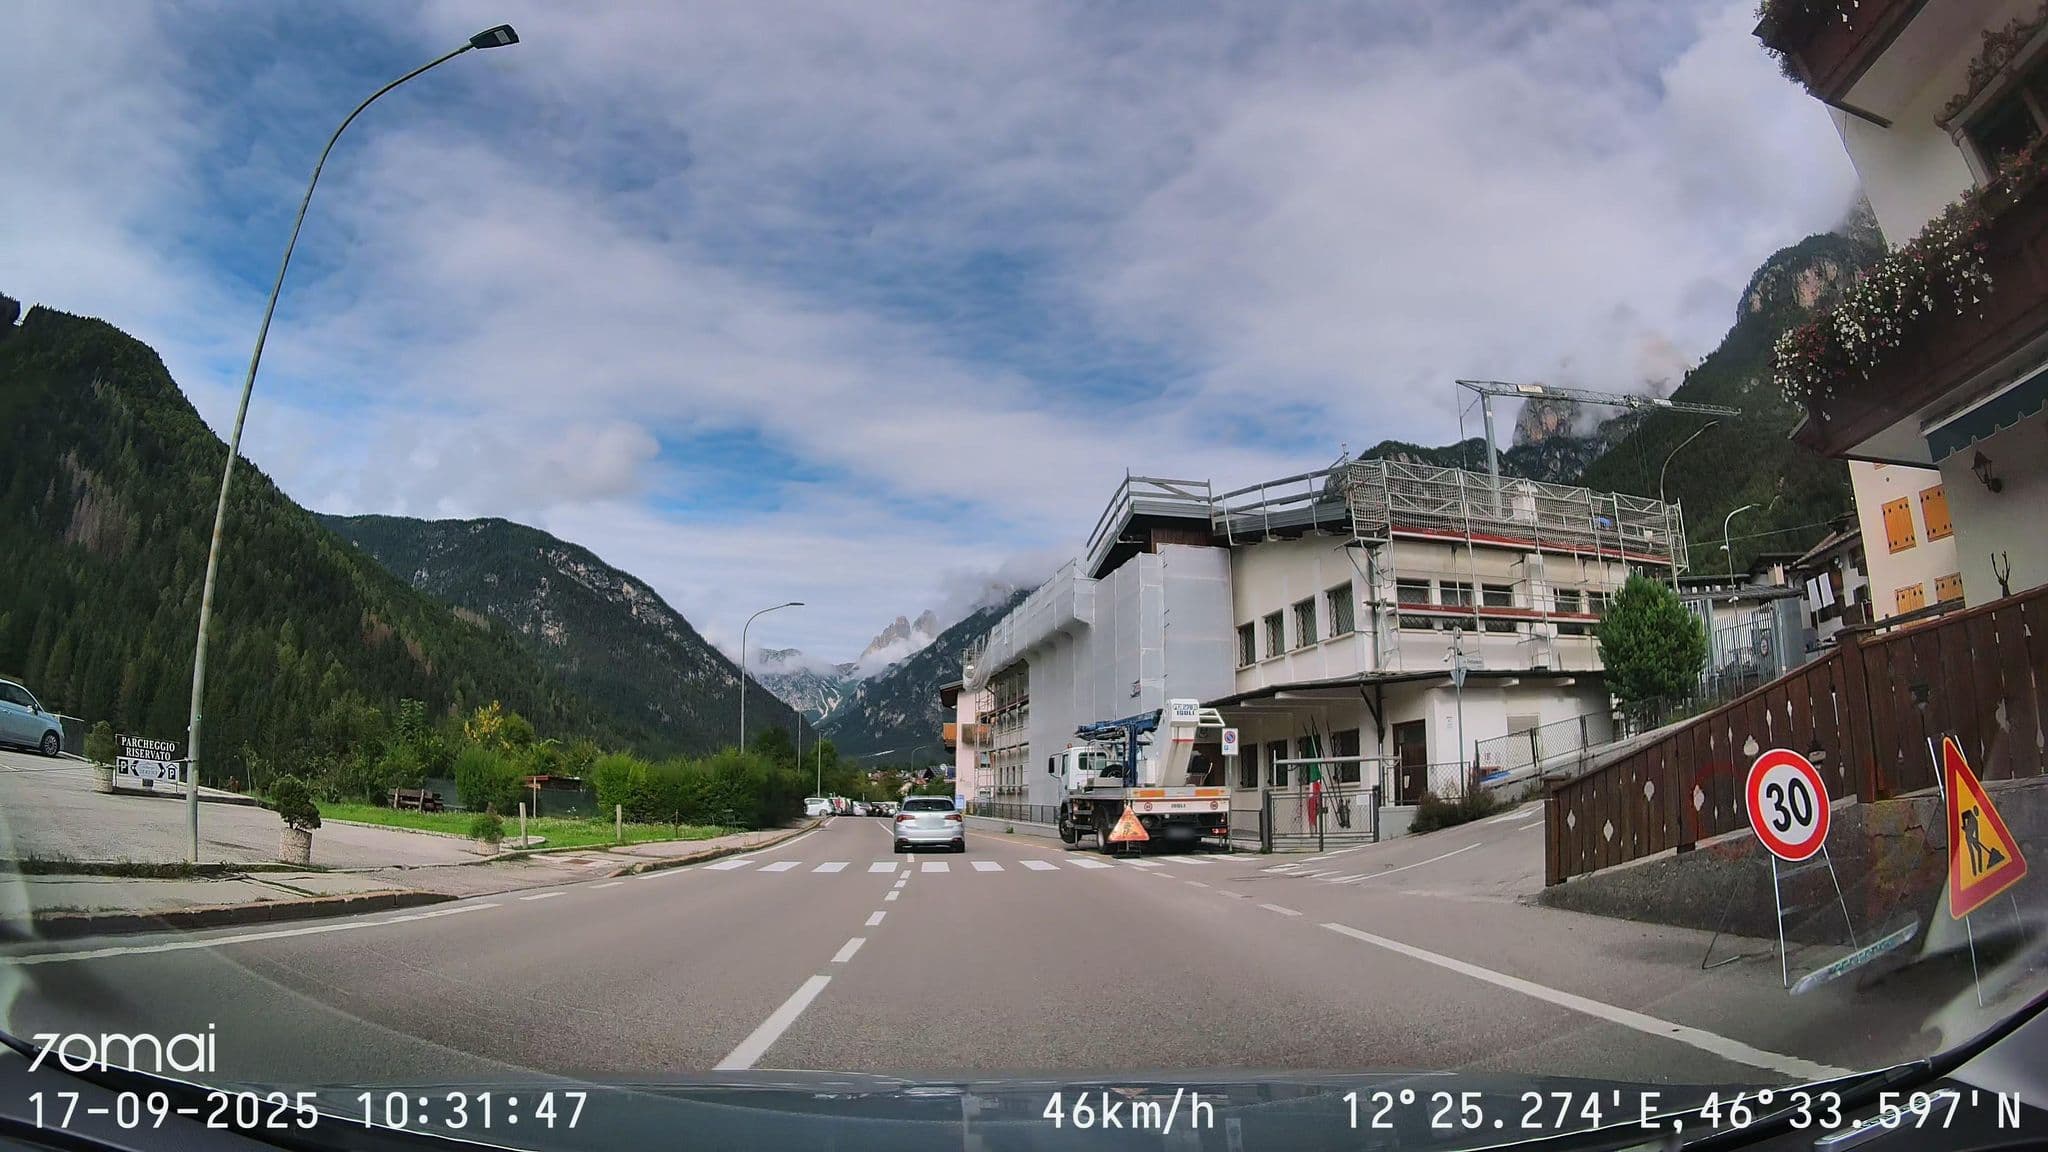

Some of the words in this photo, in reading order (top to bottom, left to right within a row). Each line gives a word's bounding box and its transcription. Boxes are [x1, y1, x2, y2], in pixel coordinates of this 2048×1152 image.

[121, 737, 175, 752] PARCHEGGIO
[126, 747, 171, 761] RISERVATO
[1766, 777, 1812, 833] 30
